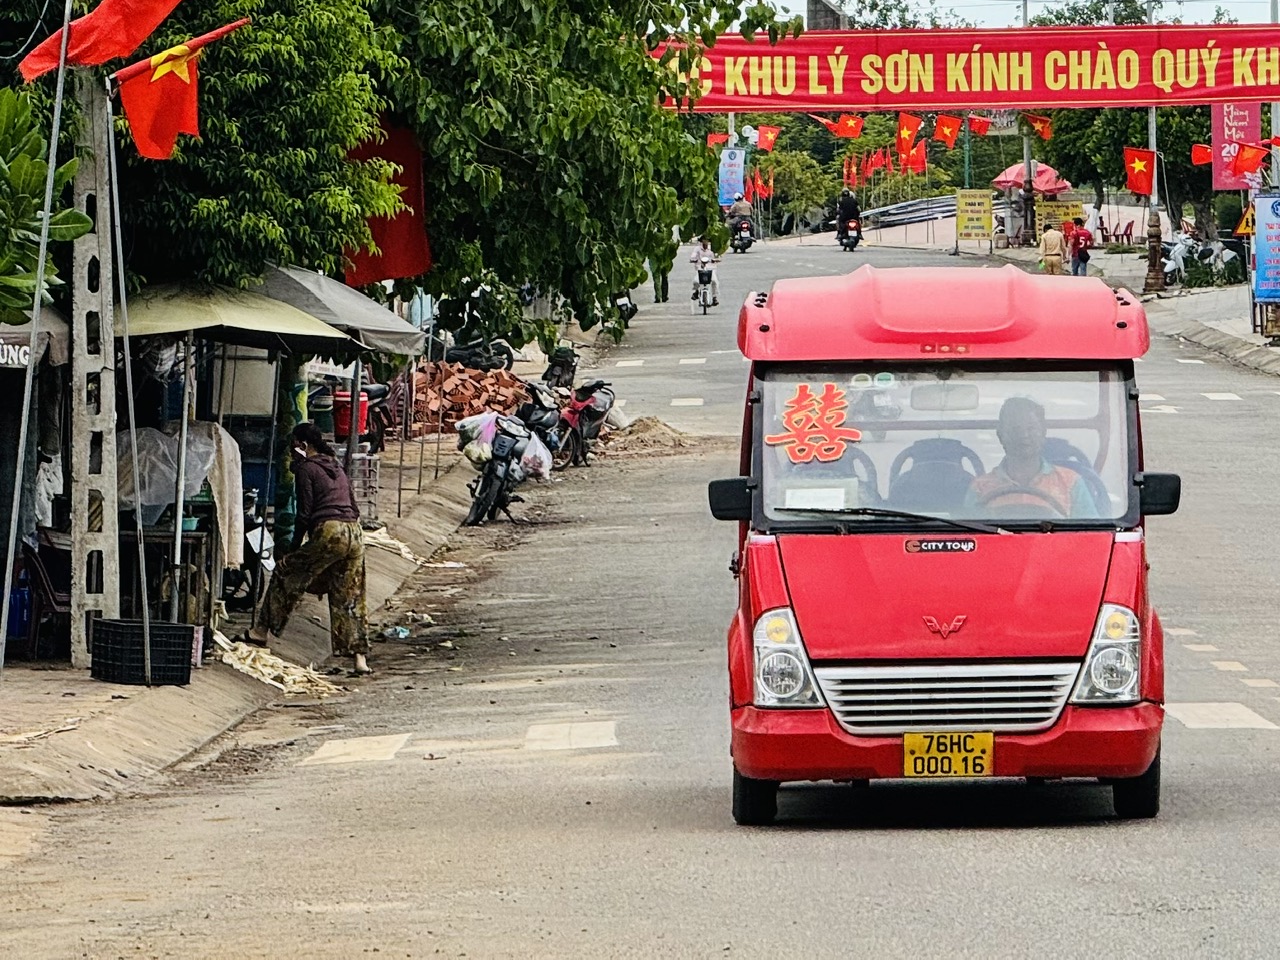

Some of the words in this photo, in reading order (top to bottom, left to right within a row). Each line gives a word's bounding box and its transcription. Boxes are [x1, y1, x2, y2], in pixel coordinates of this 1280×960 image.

[725, 55, 796, 96] KHU
[808, 45, 849, 95] LÝ
[860, 50, 935, 94] SƠN
[946, 43, 1033, 92] KÍNH
[1044, 42, 1140, 90] CHÀO
[1152, 40, 1220, 93] QUÝ
[1079, 236, 1086, 248] 5
[921, 542, 943, 550] CITY
[945, 542, 975, 552] TOUR
[923, 734, 975, 754] 76HC
[913, 756, 985, 775] 000.16
